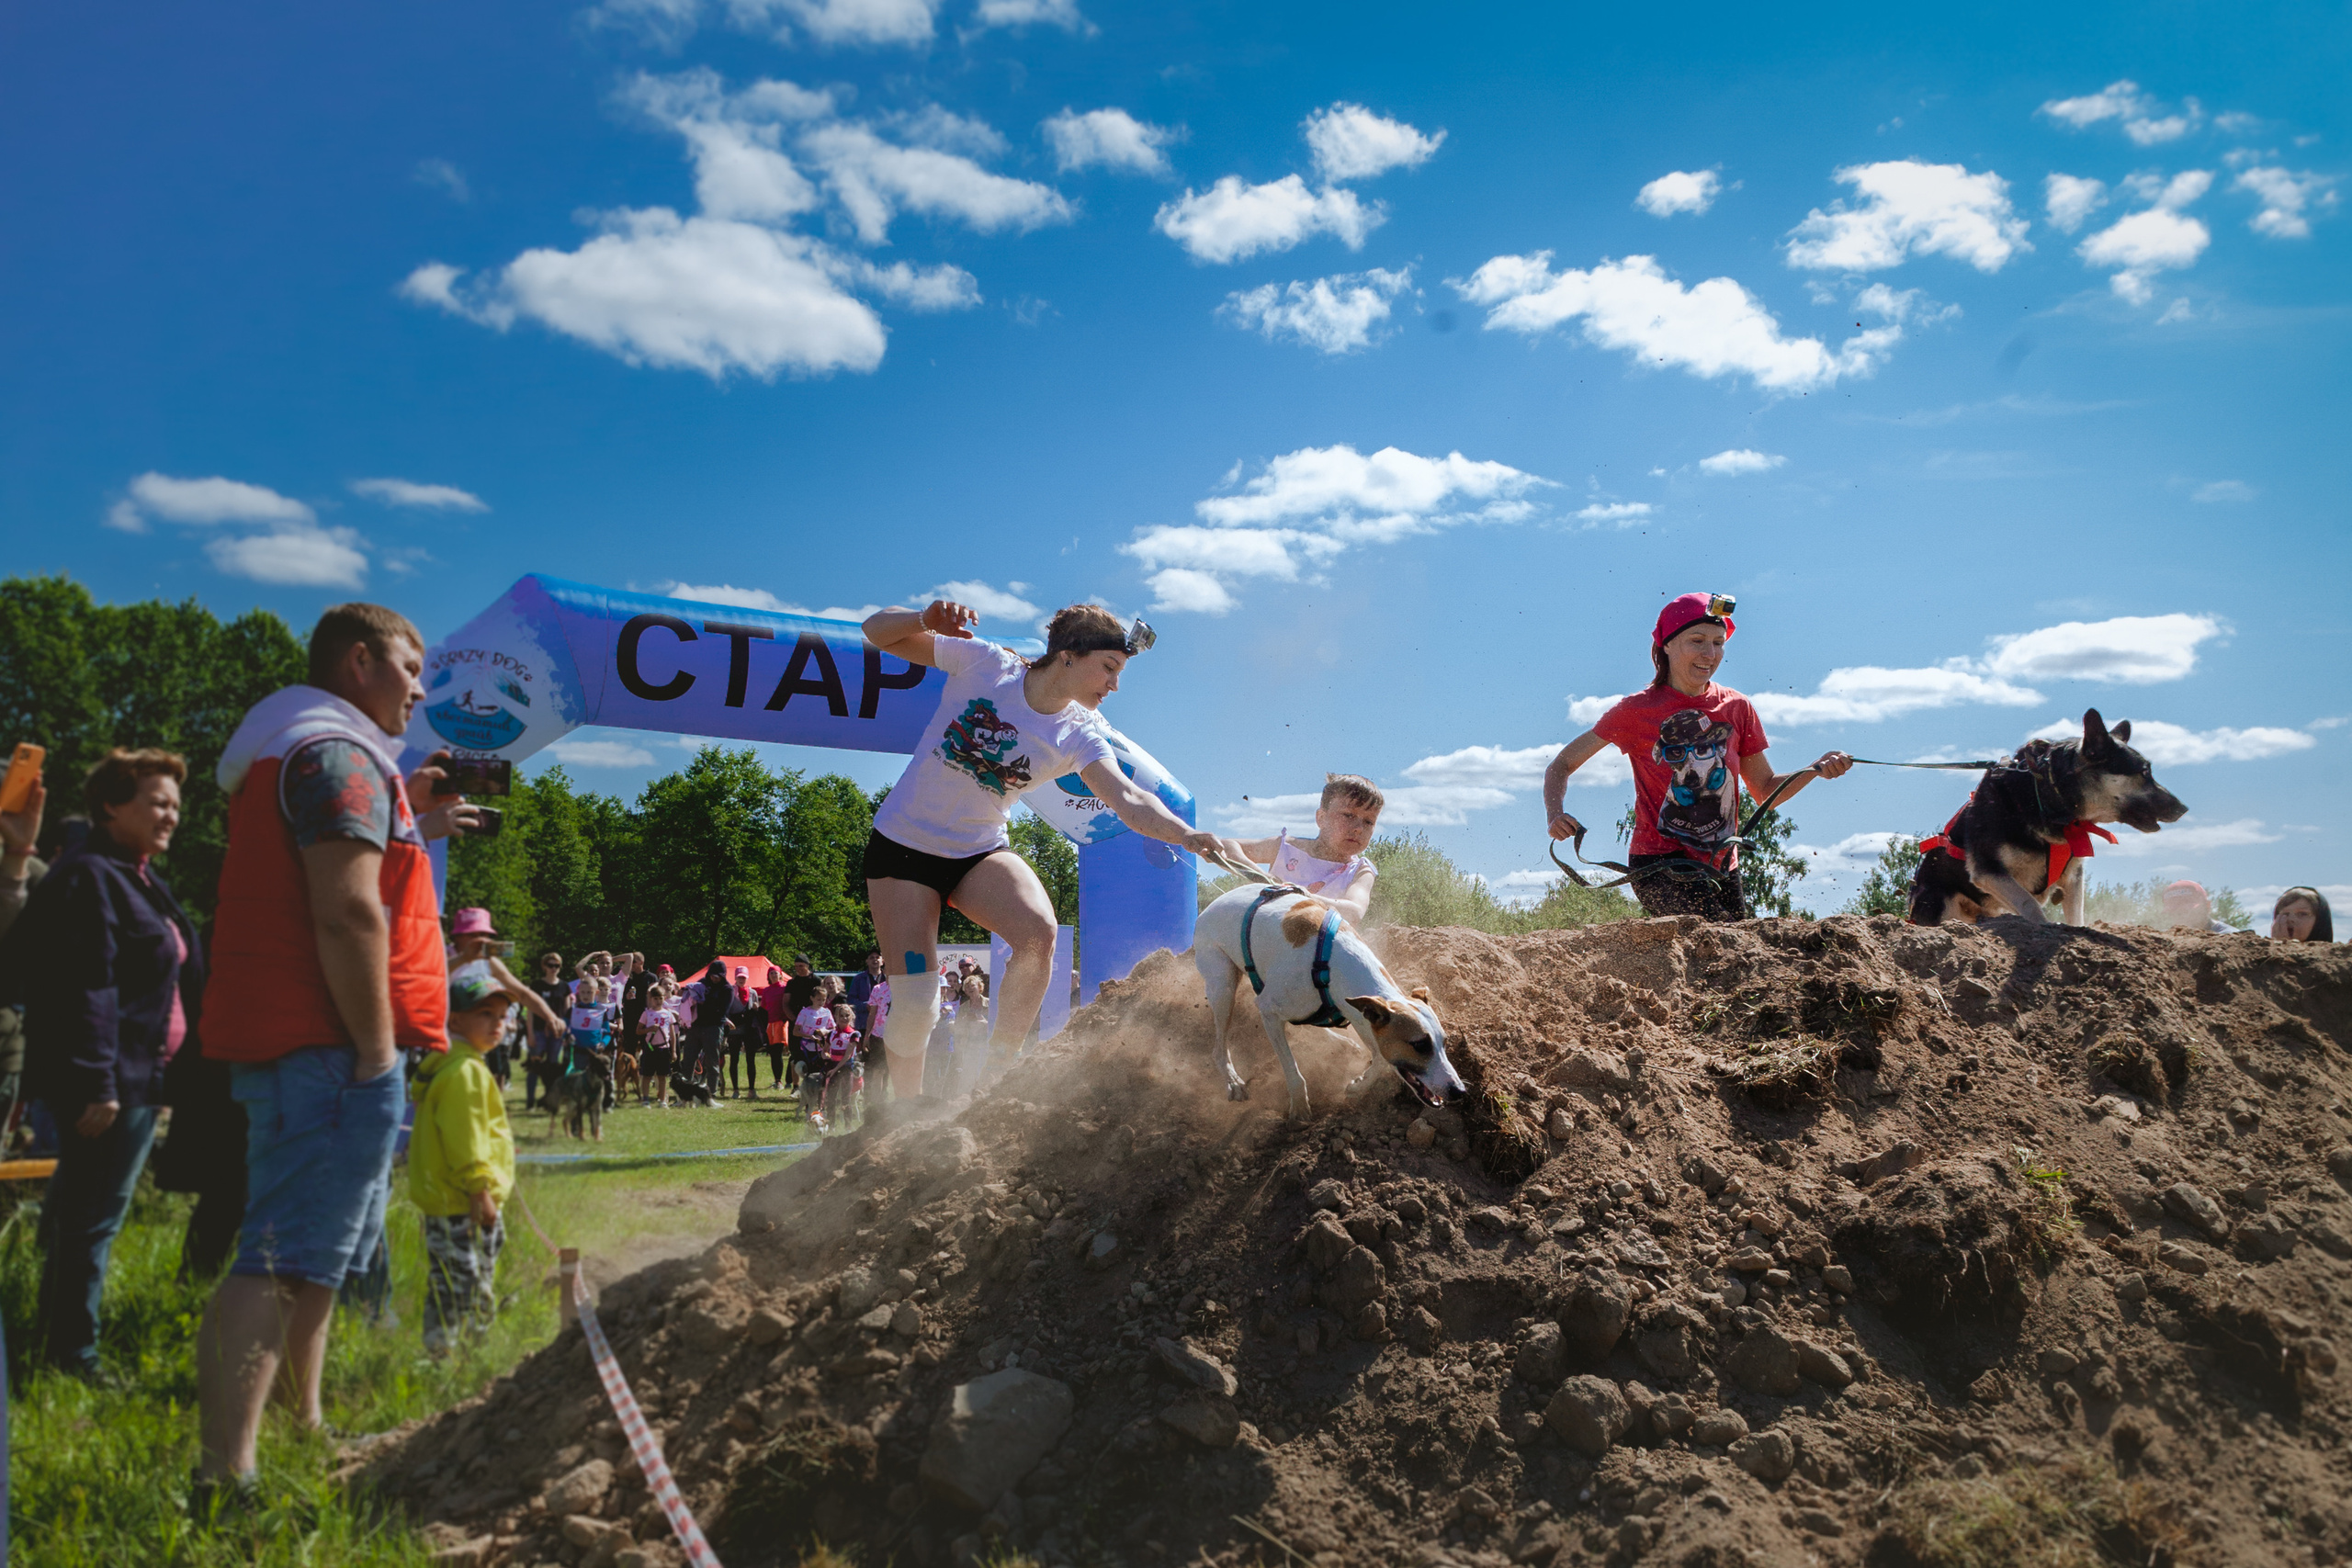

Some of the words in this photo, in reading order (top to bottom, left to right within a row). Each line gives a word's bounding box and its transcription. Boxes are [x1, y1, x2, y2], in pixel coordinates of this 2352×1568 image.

[438, 649, 485, 667] CRAZY
[492, 652, 527, 676] DOG
[1076, 798, 1110, 811] RAC
[1671, 818, 1685, 826] NO
[1685, 819, 1720, 833] RQUESTS
[582, 1017, 591, 1028] 3
